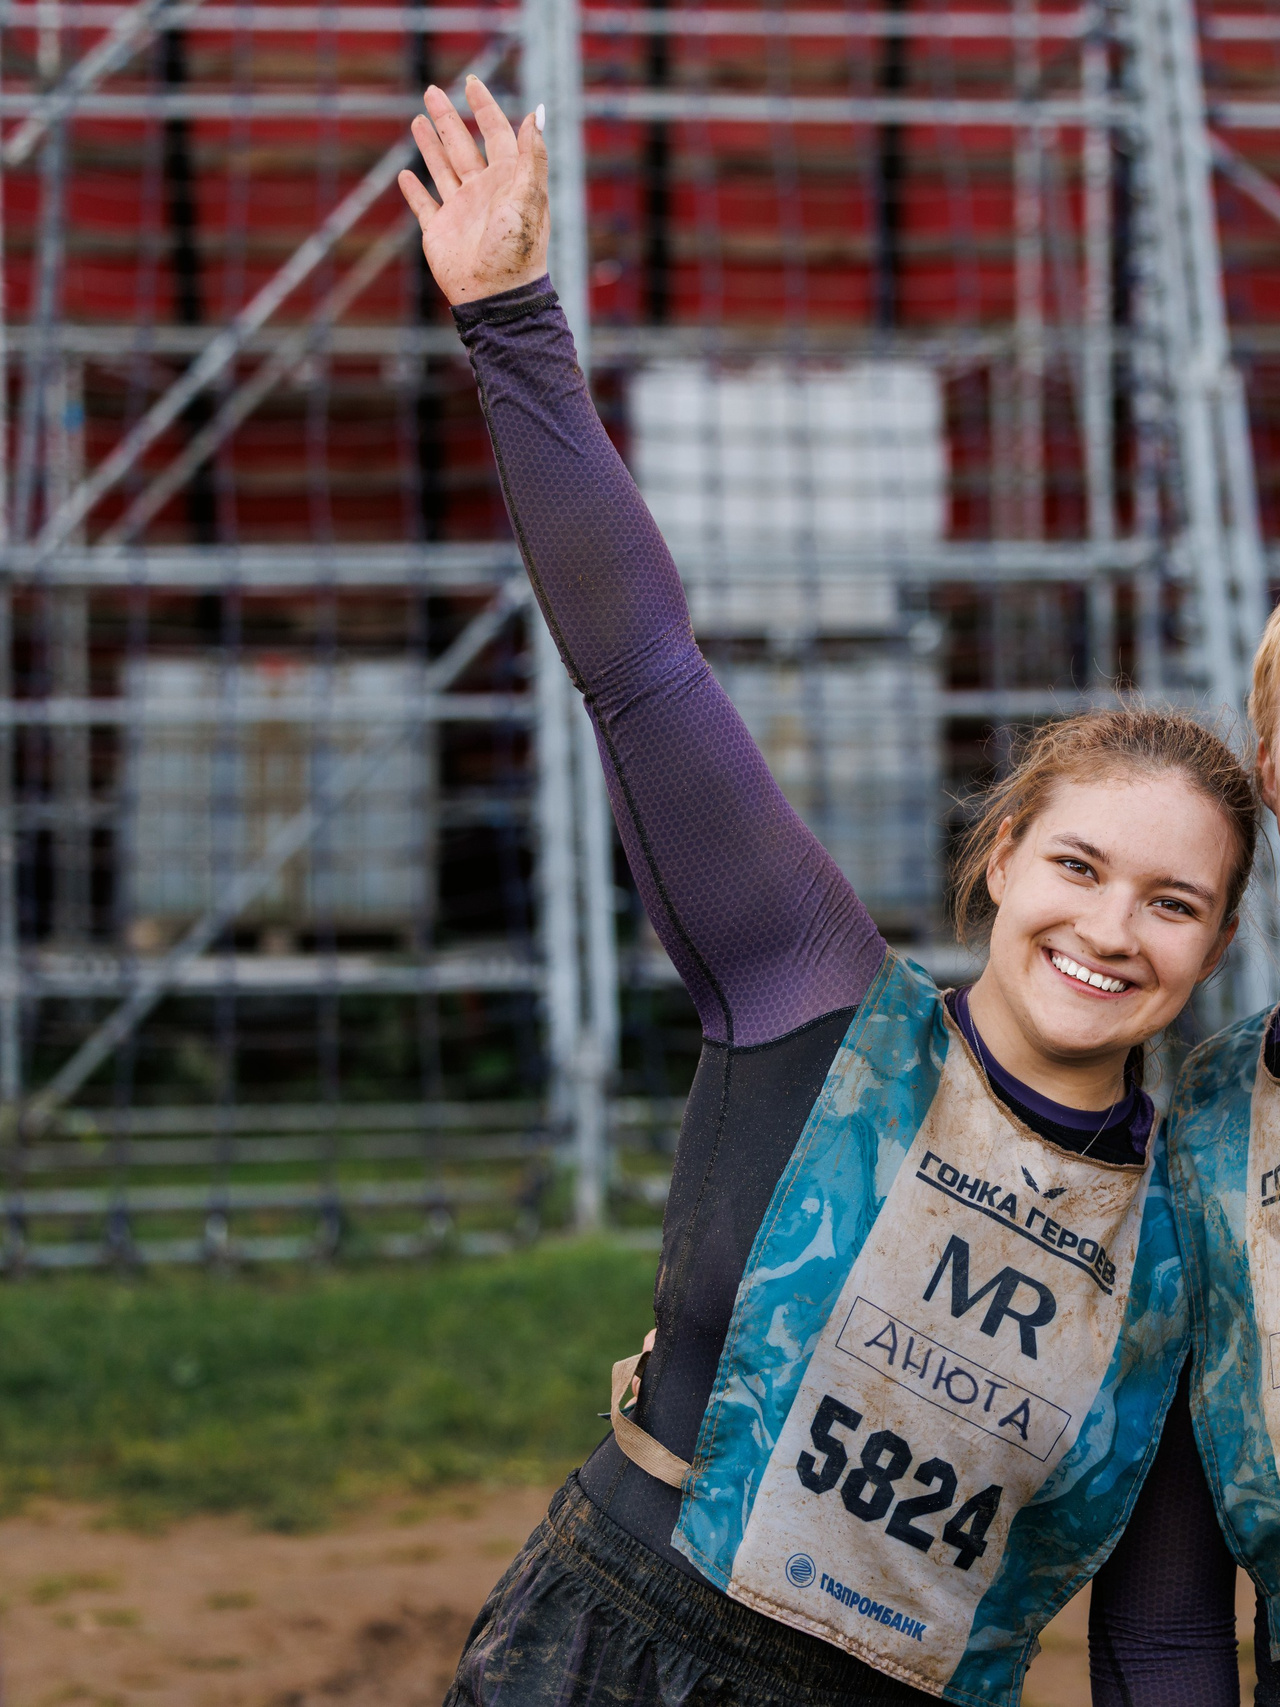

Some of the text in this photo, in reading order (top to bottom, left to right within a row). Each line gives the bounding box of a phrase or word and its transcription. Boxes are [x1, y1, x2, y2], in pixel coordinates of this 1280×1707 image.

[919, 1150, 1117, 1285] ГОНКА ГЕРОЕВ
[922, 1234, 1058, 1360] MR
[864, 1319, 1032, 1442] АНЮТА
[796, 1394, 1005, 1571] 5824
[819, 1573, 927, 1642] ГАЗПРОМБАНК
